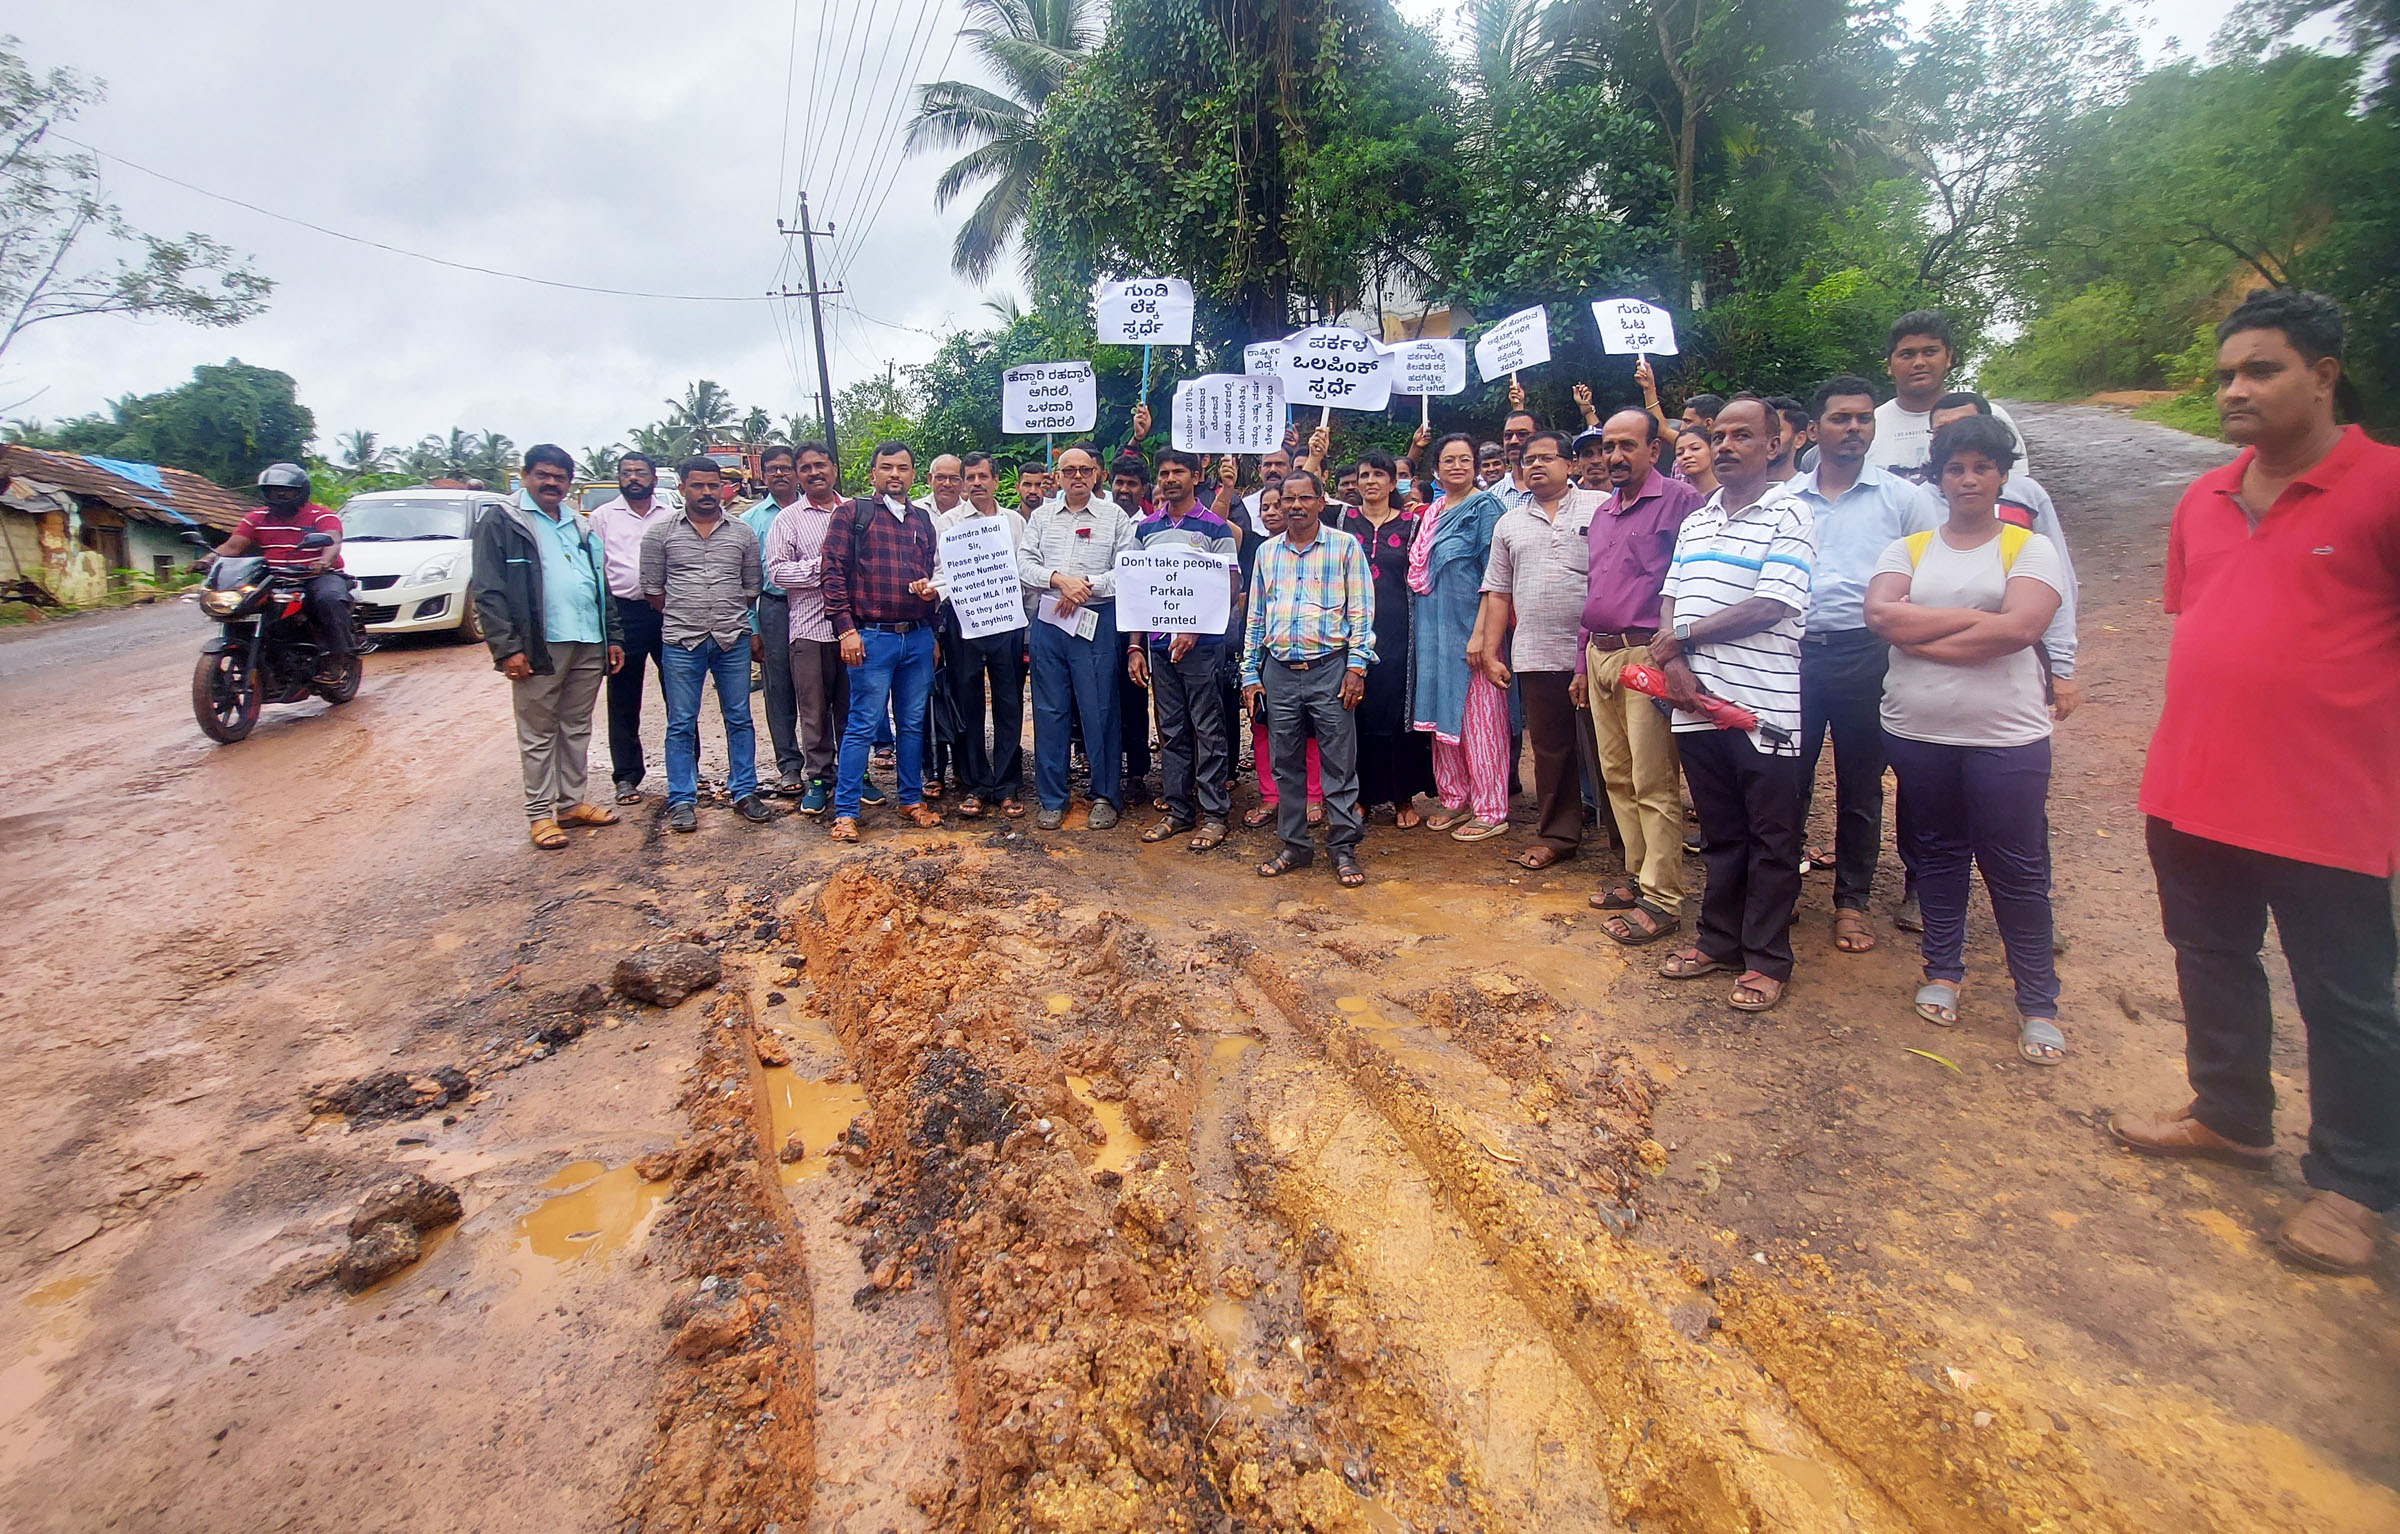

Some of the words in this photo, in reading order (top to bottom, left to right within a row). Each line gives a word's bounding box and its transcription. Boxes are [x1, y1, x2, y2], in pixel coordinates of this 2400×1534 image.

[1124, 283, 1168, 297] ಗುಂಡಿ
[1130, 299, 1160, 320] ಲೆಕ್ಕ
[1617, 303, 1651, 315] ಗುಂಡಿ
[1123, 319, 1164, 340] ಸ್ಪರ್ಧೆ
[1621, 318, 1645, 330] ಓಟ
[1309, 334, 1368, 352] ಪರ್ಕಳ
[1416, 343, 1436, 353] ನಮ್ಮ
[1625, 333, 1655, 350] ಸ್ಪರ್ಧೆ
[1293, 356, 1380, 375] ಒಲಪಿಂಕ್
[1433, 363, 1447, 374] ರಸ್ತೆ
[1500, 358, 1523, 372] ತರಬೇತಿ
[1007, 369, 1045, 386] ಹೆದ್ದಾರಿ
[1029, 385, 1072, 397] ಆಗಿರಲಿ,
[1308, 377, 1356, 400] ಸ್ಪರ್ಧೆ
[1425, 384, 1446, 392] ಆಗಿದೆ
[1027, 401, 1073, 412] ಒಳದಾರಿ
[1199, 387, 1208, 440] ಪ್ರಾರಂಭವಾದ
[1211, 396, 1219, 431] ಯೋಜನೆ
[1025, 416, 1075, 428] ಆಗದಿರಲಿ
[1185, 415, 1193, 449] October
[1224, 420, 1232, 445] ಎರಡು
[946, 528, 980, 543] Narendra
[981, 524, 1001, 535] Modi
[968, 543, 981, 551] Sir,
[947, 557, 972, 569] Please
[974, 554, 990, 565] give
[991, 549, 1009, 558] your
[1121, 557, 1152, 567] Don't
[1155, 557, 1180, 568] take
[1183, 559, 1223, 570] people
[953, 570, 975, 582] phone
[977, 563, 1009, 575] Number.
[1165, 572, 1178, 582] of
[951, 586, 963, 594] We
[965, 580, 986, 591] voted
[987, 577, 998, 585] for
[999, 575, 1016, 585] you.
[1150, 586, 1194, 597] Parkala
[955, 599, 968, 607] Not
[970, 595, 981, 603] our
[984, 590, 1000, 599] MLA
[1006, 585, 1019, 594] MP.
[965, 609, 976, 617] So
[977, 604, 993, 616] they
[995, 600, 1014, 609] don't
[1163, 600, 1181, 610] for
[971, 620, 980, 629] do
[982, 614, 1015, 627] anything.
[1151, 615, 1197, 626] granted
